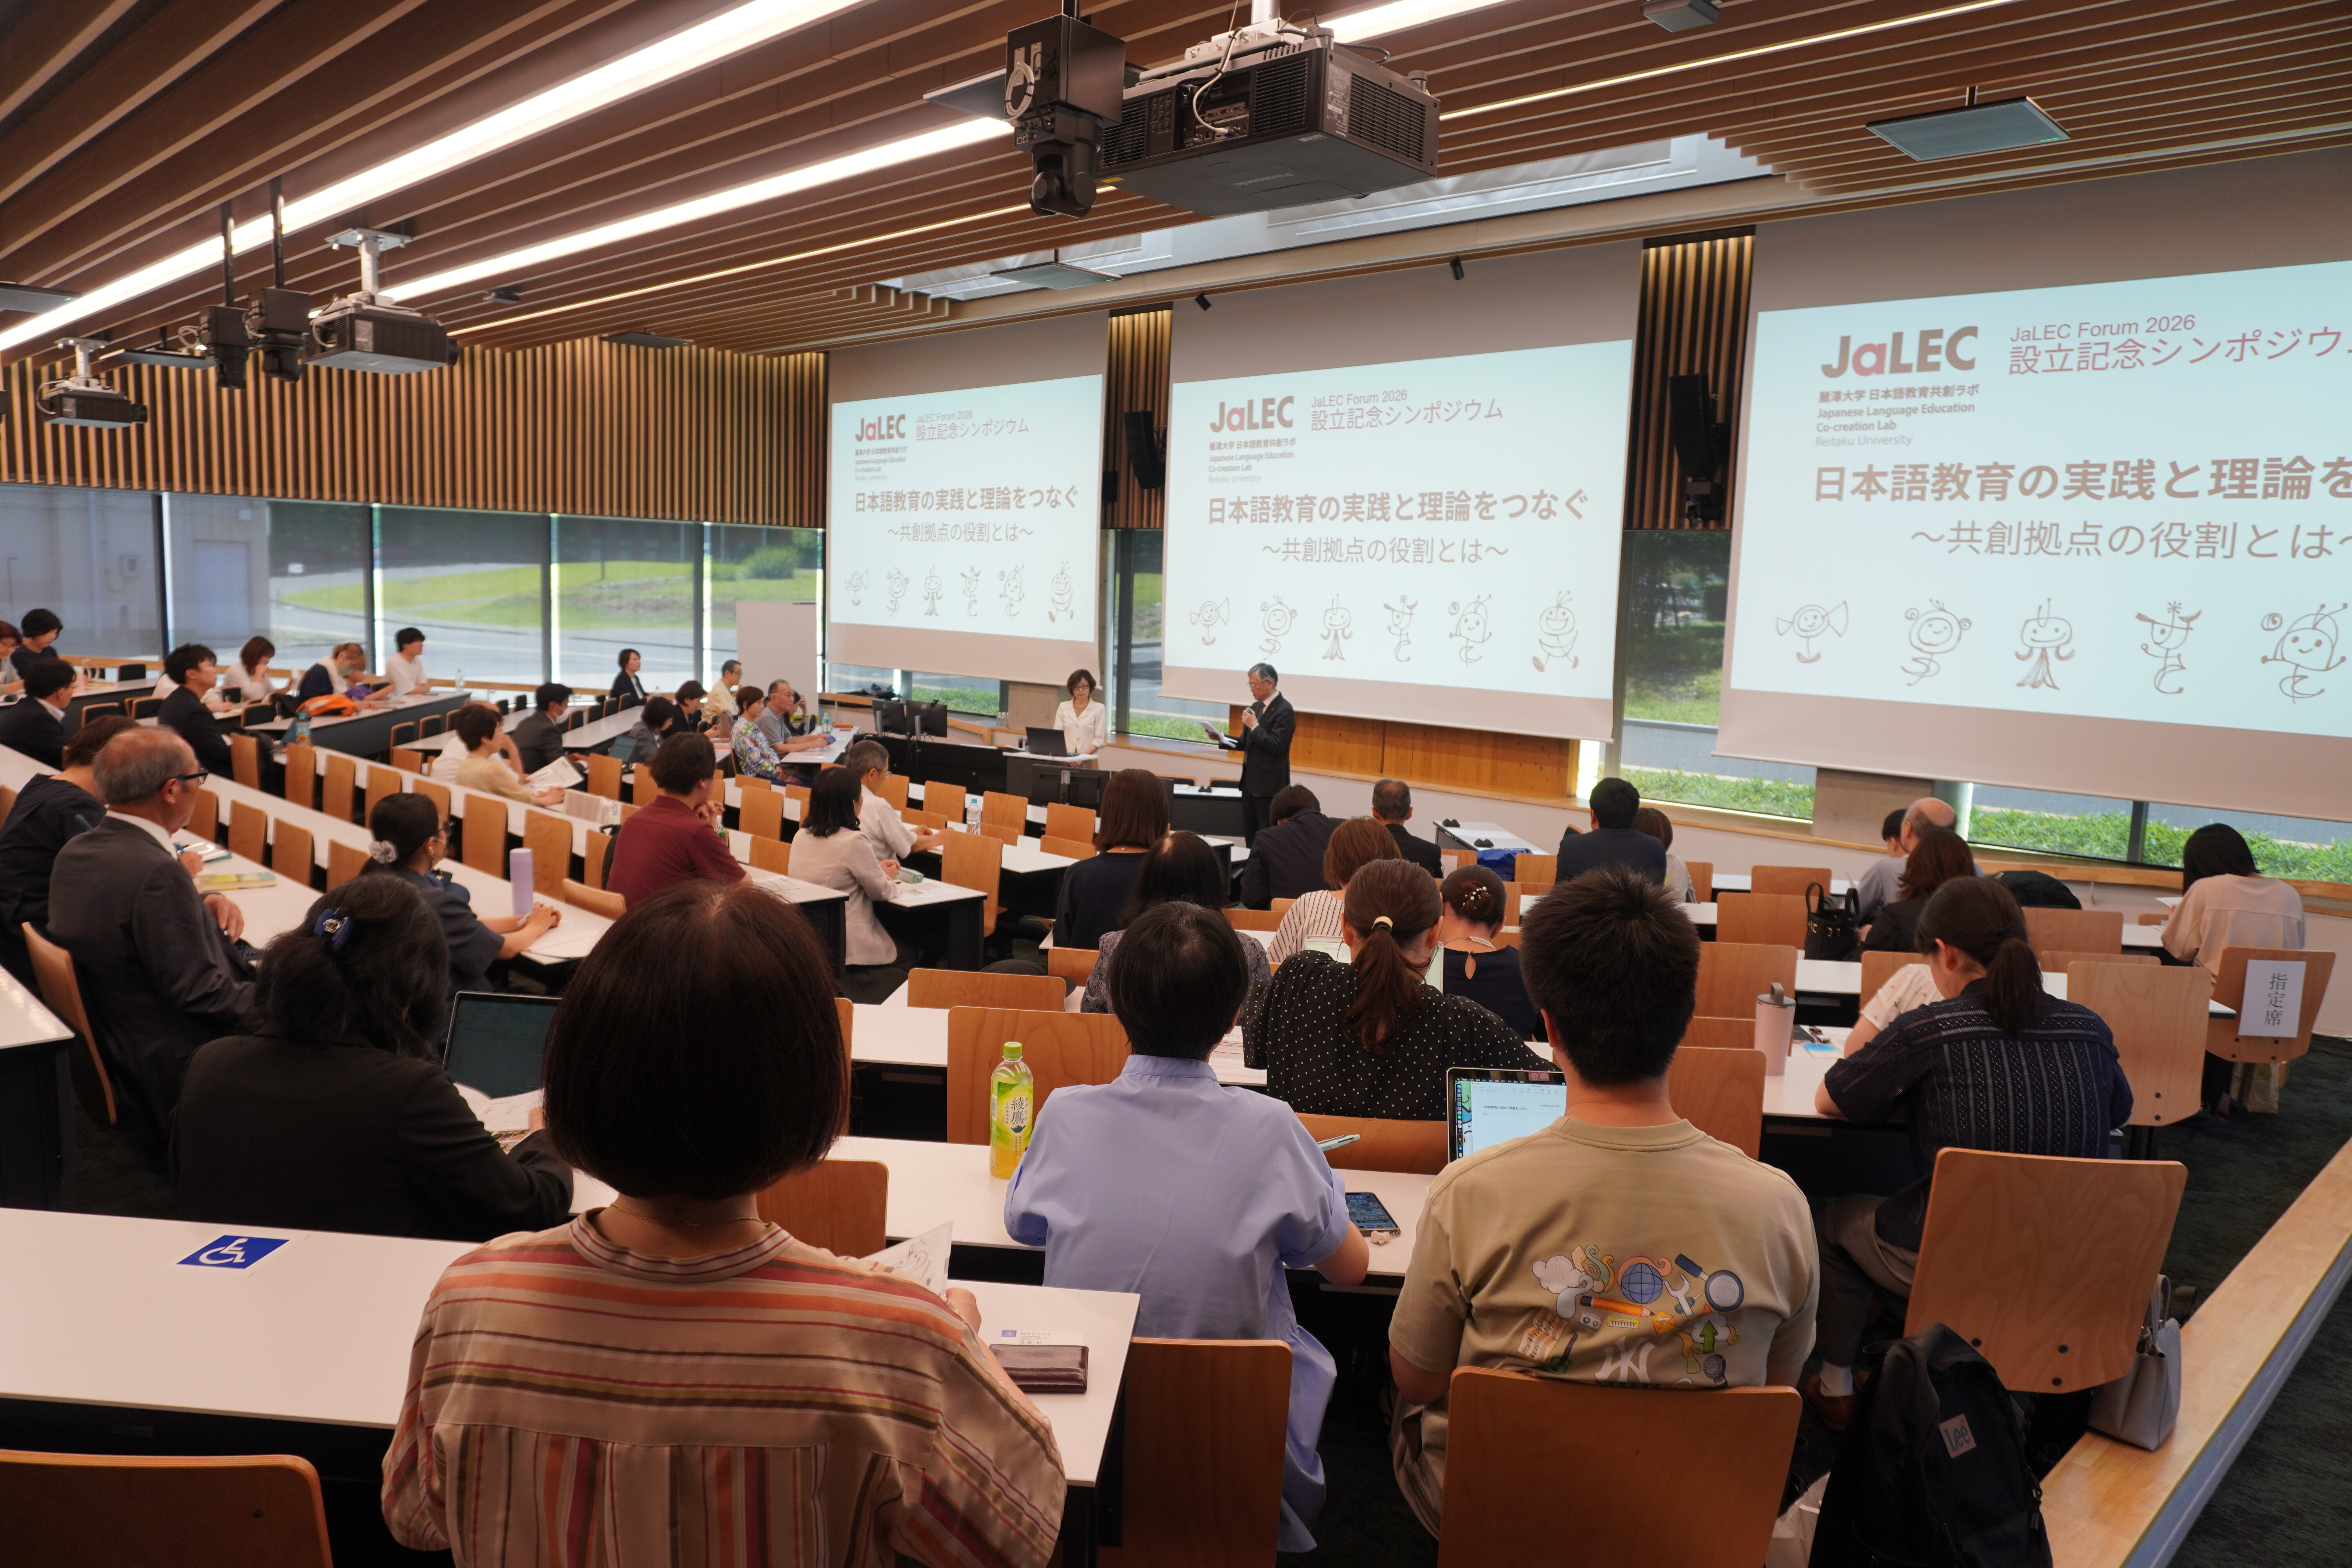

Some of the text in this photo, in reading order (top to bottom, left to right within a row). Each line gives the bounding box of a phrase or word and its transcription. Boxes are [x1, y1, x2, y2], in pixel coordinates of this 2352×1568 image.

[2011, 314, 2196, 342] JaLEC Forum 2026
[1821, 325, 1979, 378] JaLEC
[2009, 325, 2352, 376] 設立記念シンポジウ
[1311, 390, 1408, 408] JaLEC Forum 2026
[1817, 403, 1975, 419] Japanese Language Education
[855, 414, 906, 442] JaLEC
[916, 410, 973, 423] JaLEC Forum 2026
[1210, 396, 1294, 433] JaLEC
[1311, 397, 1504, 431] 設立記念シンポジウム
[1817, 420, 1896, 432] Co-creation Lab
[916, 418, 1029, 441] 設立記念シンポジウム
[1816, 435, 1912, 446] Reitaku University
[1209, 454, 1234, 463] Japanese
[1235, 453, 1263, 461] Language
[855, 485, 1078, 513] 日本語教育の実践と理論をつなぐ
[1208, 487, 1589, 524] 日本語教育の実践と理論をつなぐ
[2265, 973, 2287, 1026] 指定席
[1011, 1096, 1024, 1125] 綾鷹
[1944, 1424, 1971, 1450] Lee
